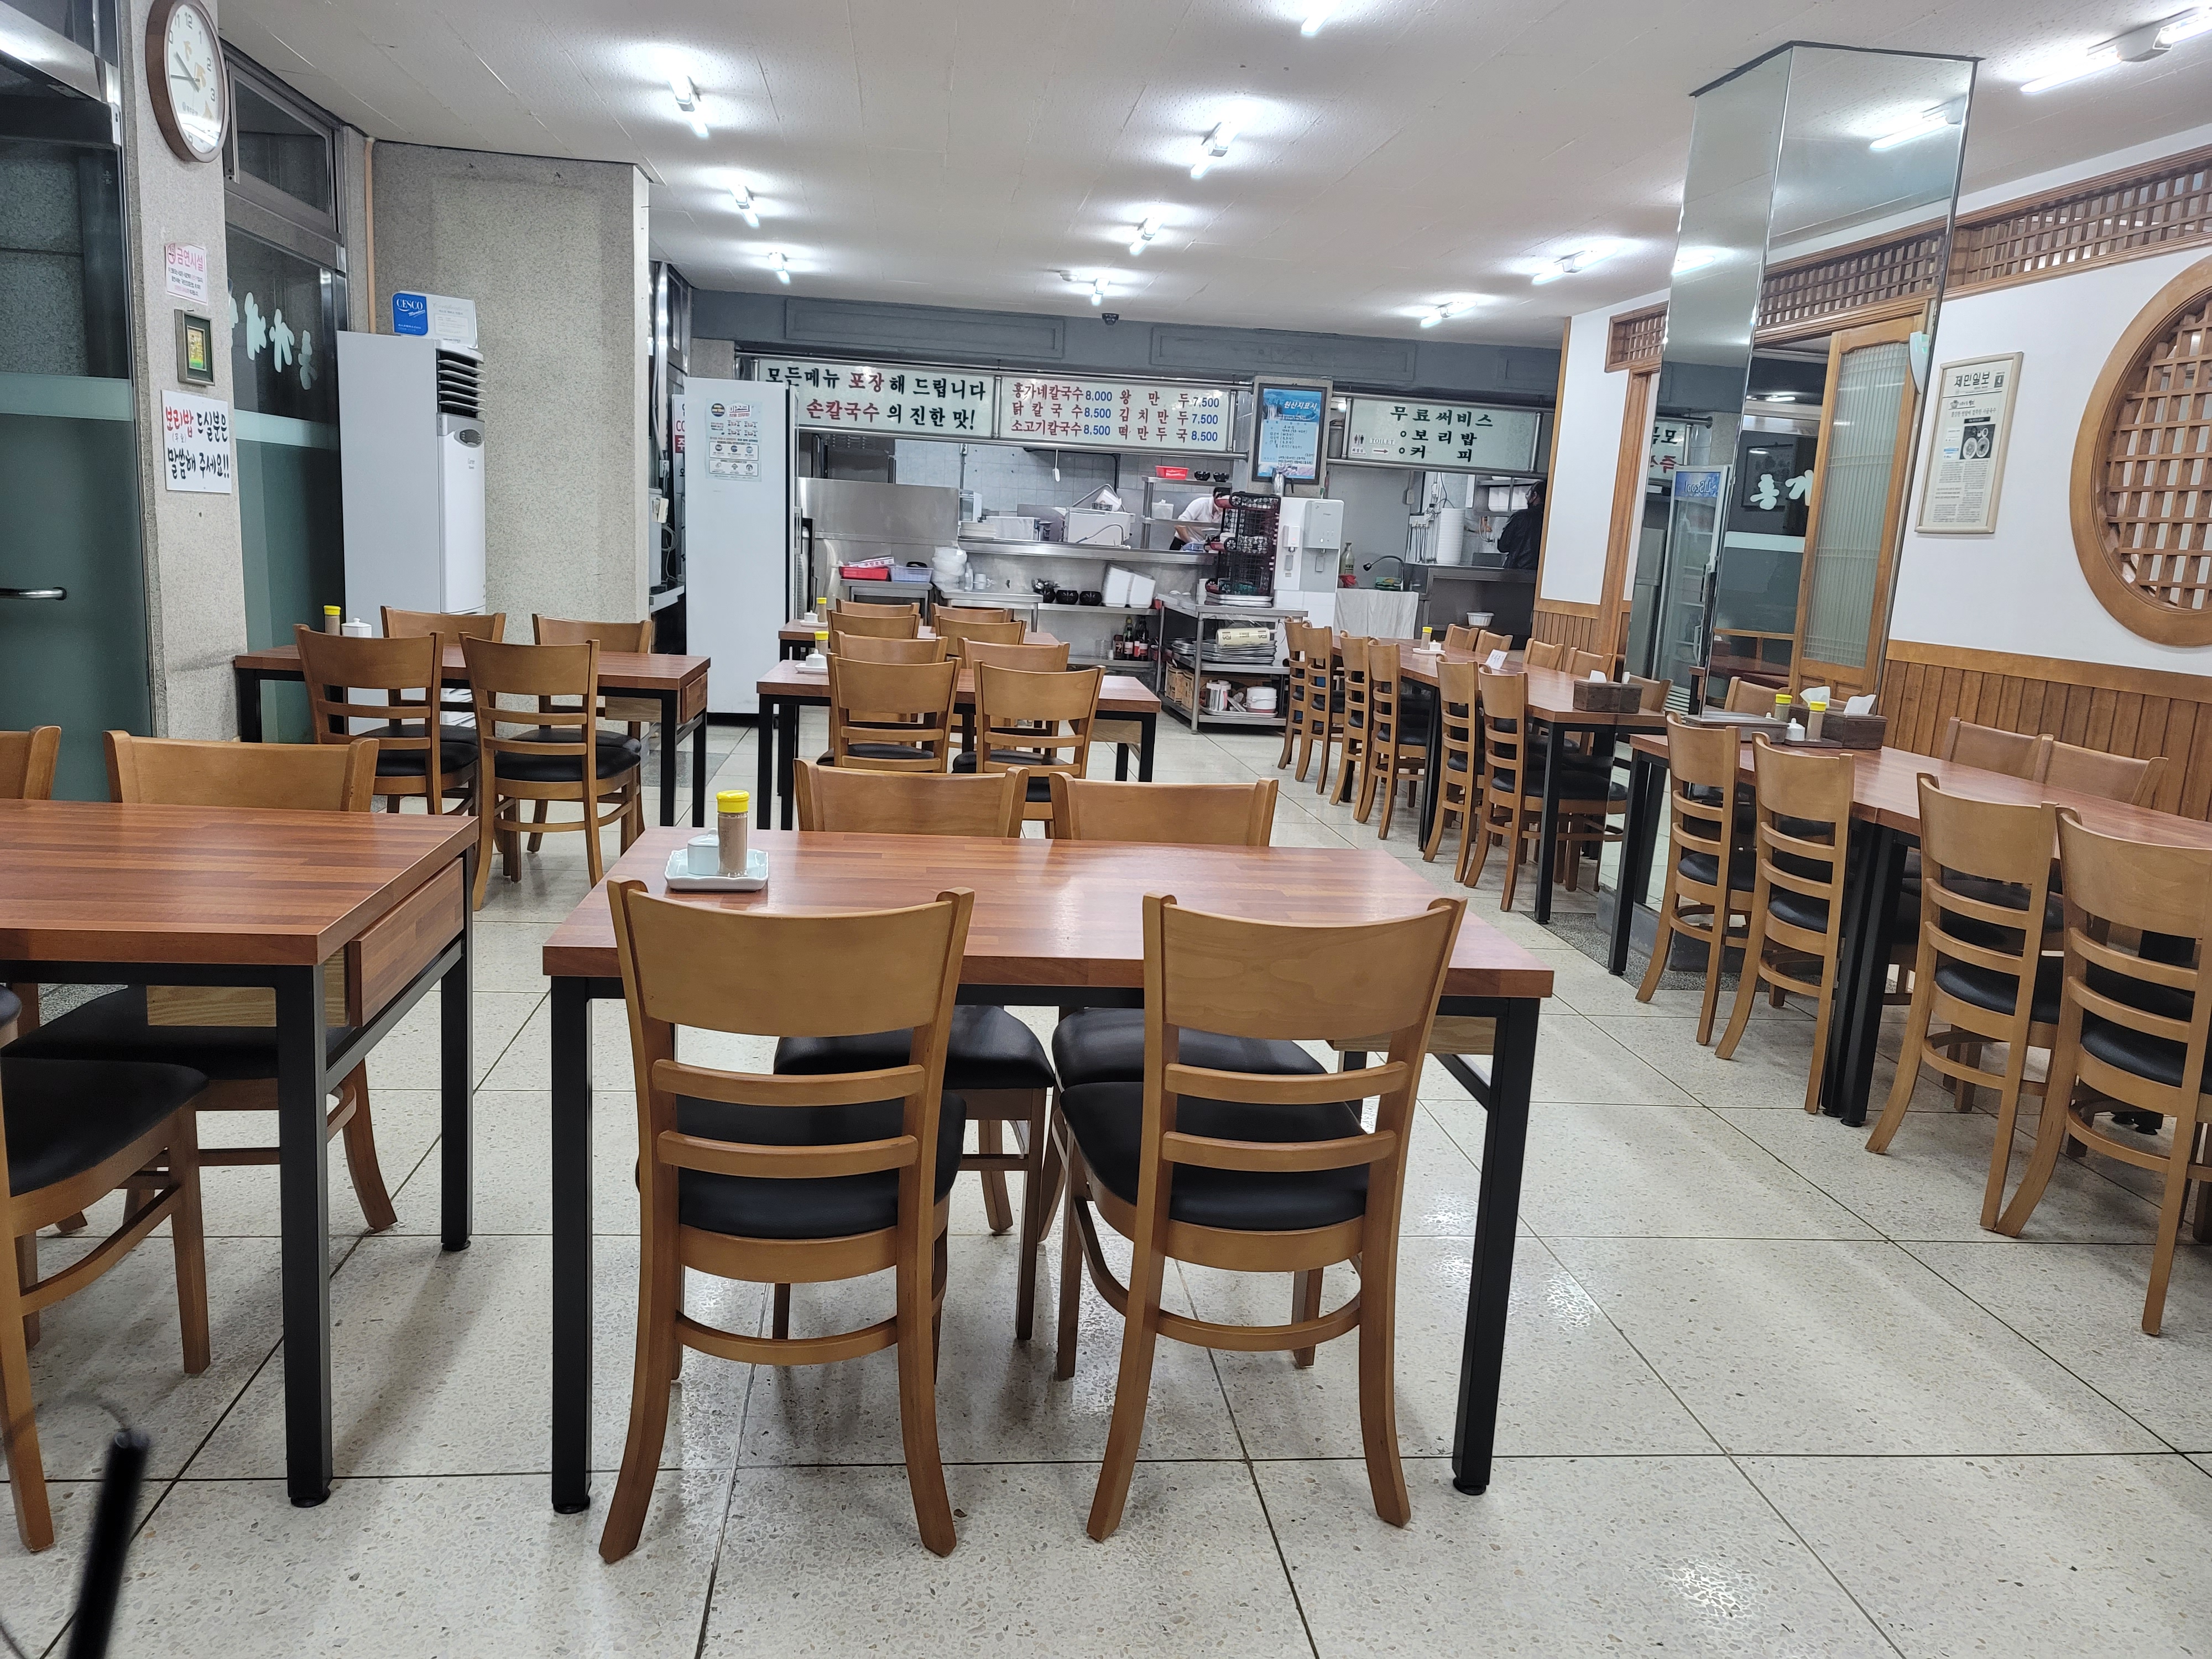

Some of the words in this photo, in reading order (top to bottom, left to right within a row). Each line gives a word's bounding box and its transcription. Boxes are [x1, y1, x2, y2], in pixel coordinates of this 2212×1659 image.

[185, 12, 193, 29] 12
[207, 57, 212, 72] 2
[210, 87, 216, 102] 3
[177, 247, 204, 272] 금연시설
[396, 298, 423, 310] CESCO
[848, 372, 884, 393] 포장
[889, 375, 905, 395] 해
[912, 378, 986, 401] 드립니다
[1954, 371, 1990, 387] 제민일보
[1997, 375, 2002, 384] 4
[1012, 382, 1084, 402] 홍가네칼국수
[1086, 390, 1113, 402] 8,000
[1193, 397, 1220, 408] 7,500
[729, 404, 750, 413] 마스크
[1284, 401, 1317, 410] 원산지표시
[806, 399, 880, 422] 손칼국수
[886, 404, 902, 424] 의
[910, 404, 946, 427] 진한
[953, 409, 975, 430] 맛!
[1084, 408, 1112, 419] 8,500
[1191, 413, 1218, 425] 7,500
[165, 406, 194, 438] 보리밥
[196, 410, 228, 442] 드실분은
[1011, 420, 1082, 437] 소고기칼국수
[1083, 425, 1110, 436] 8,500
[1191, 431, 1218, 442] 8,500
[168, 447, 196, 479] 말씀해
[199, 452, 229, 479] 주세요!!
